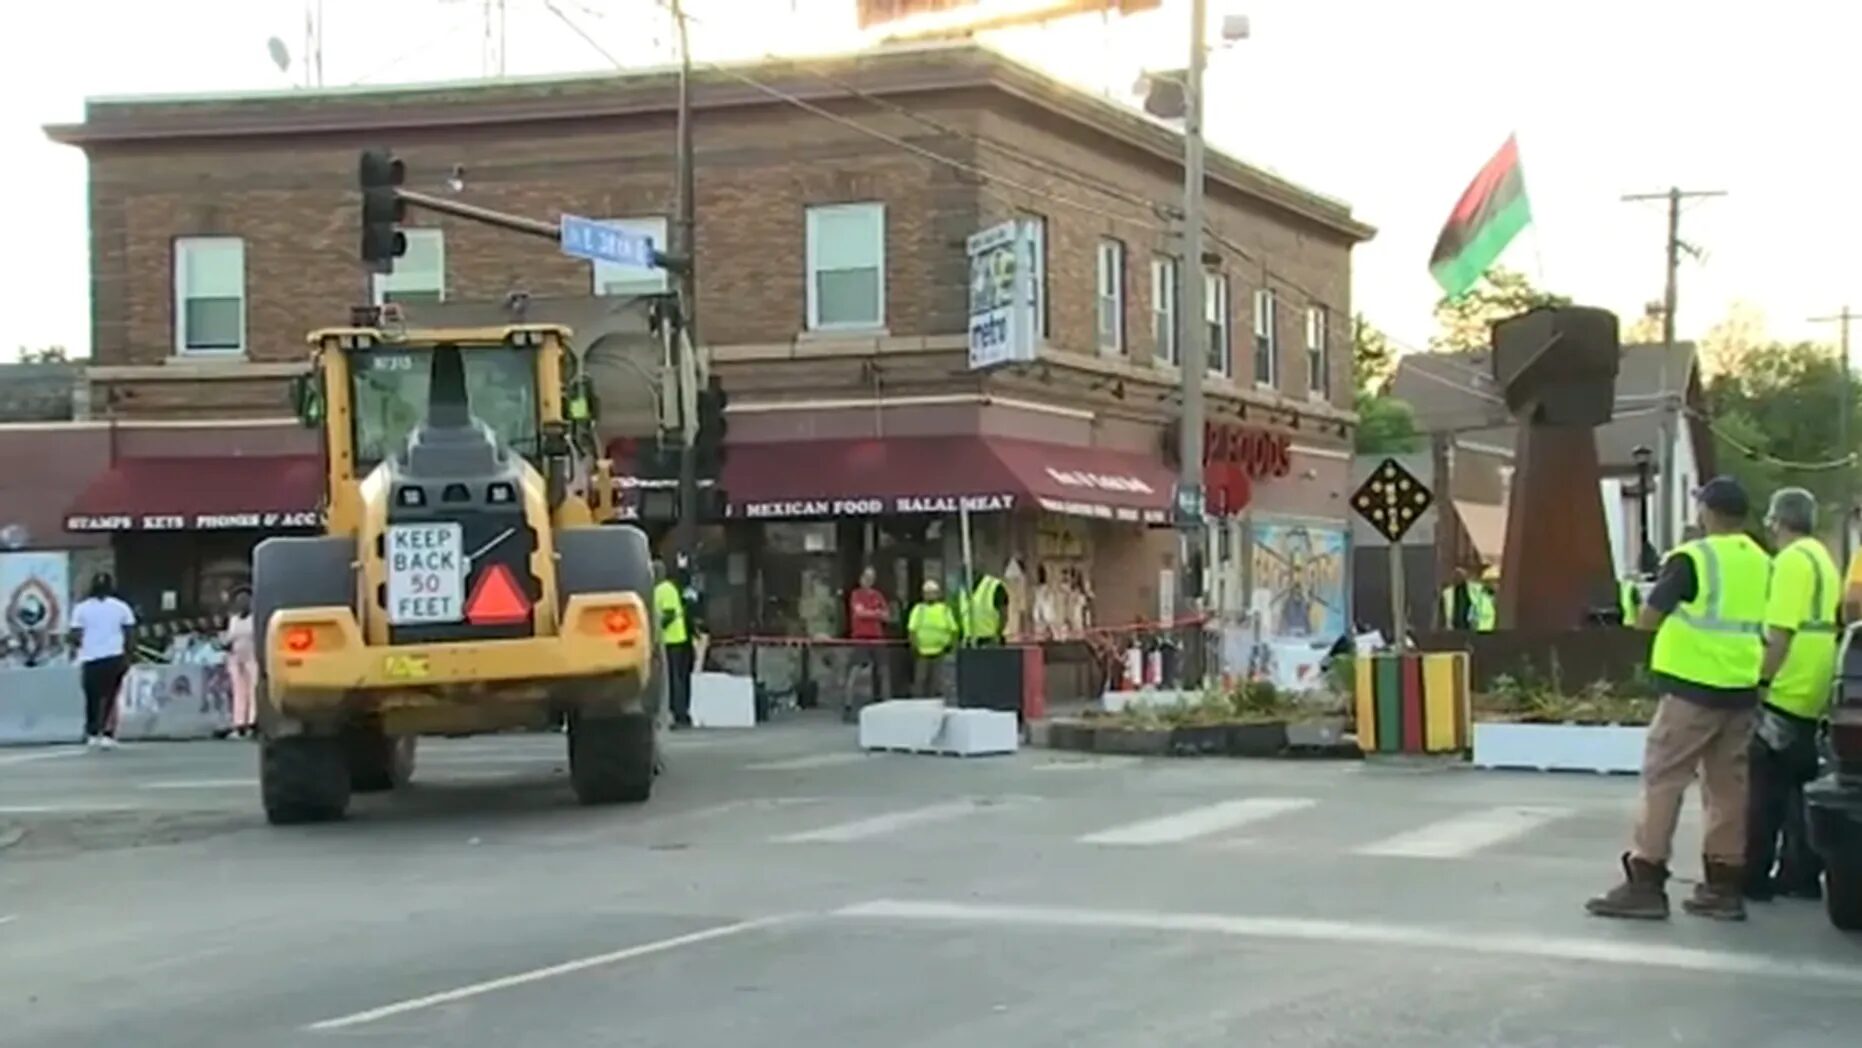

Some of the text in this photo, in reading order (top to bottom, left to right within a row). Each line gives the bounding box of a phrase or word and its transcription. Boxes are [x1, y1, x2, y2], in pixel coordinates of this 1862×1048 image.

[746, 494, 1014, 517] MEXICAN FOOD HALAL MEAT
[68, 515, 132, 530] STAMPS
[143, 515, 184, 530] KEYS
[196, 514, 260, 528] PHONES
[395, 530, 452, 548] KEEP
[393, 551, 455, 572] BACK
[410, 573, 440, 593] 50
[399, 596, 452, 616] FEET
